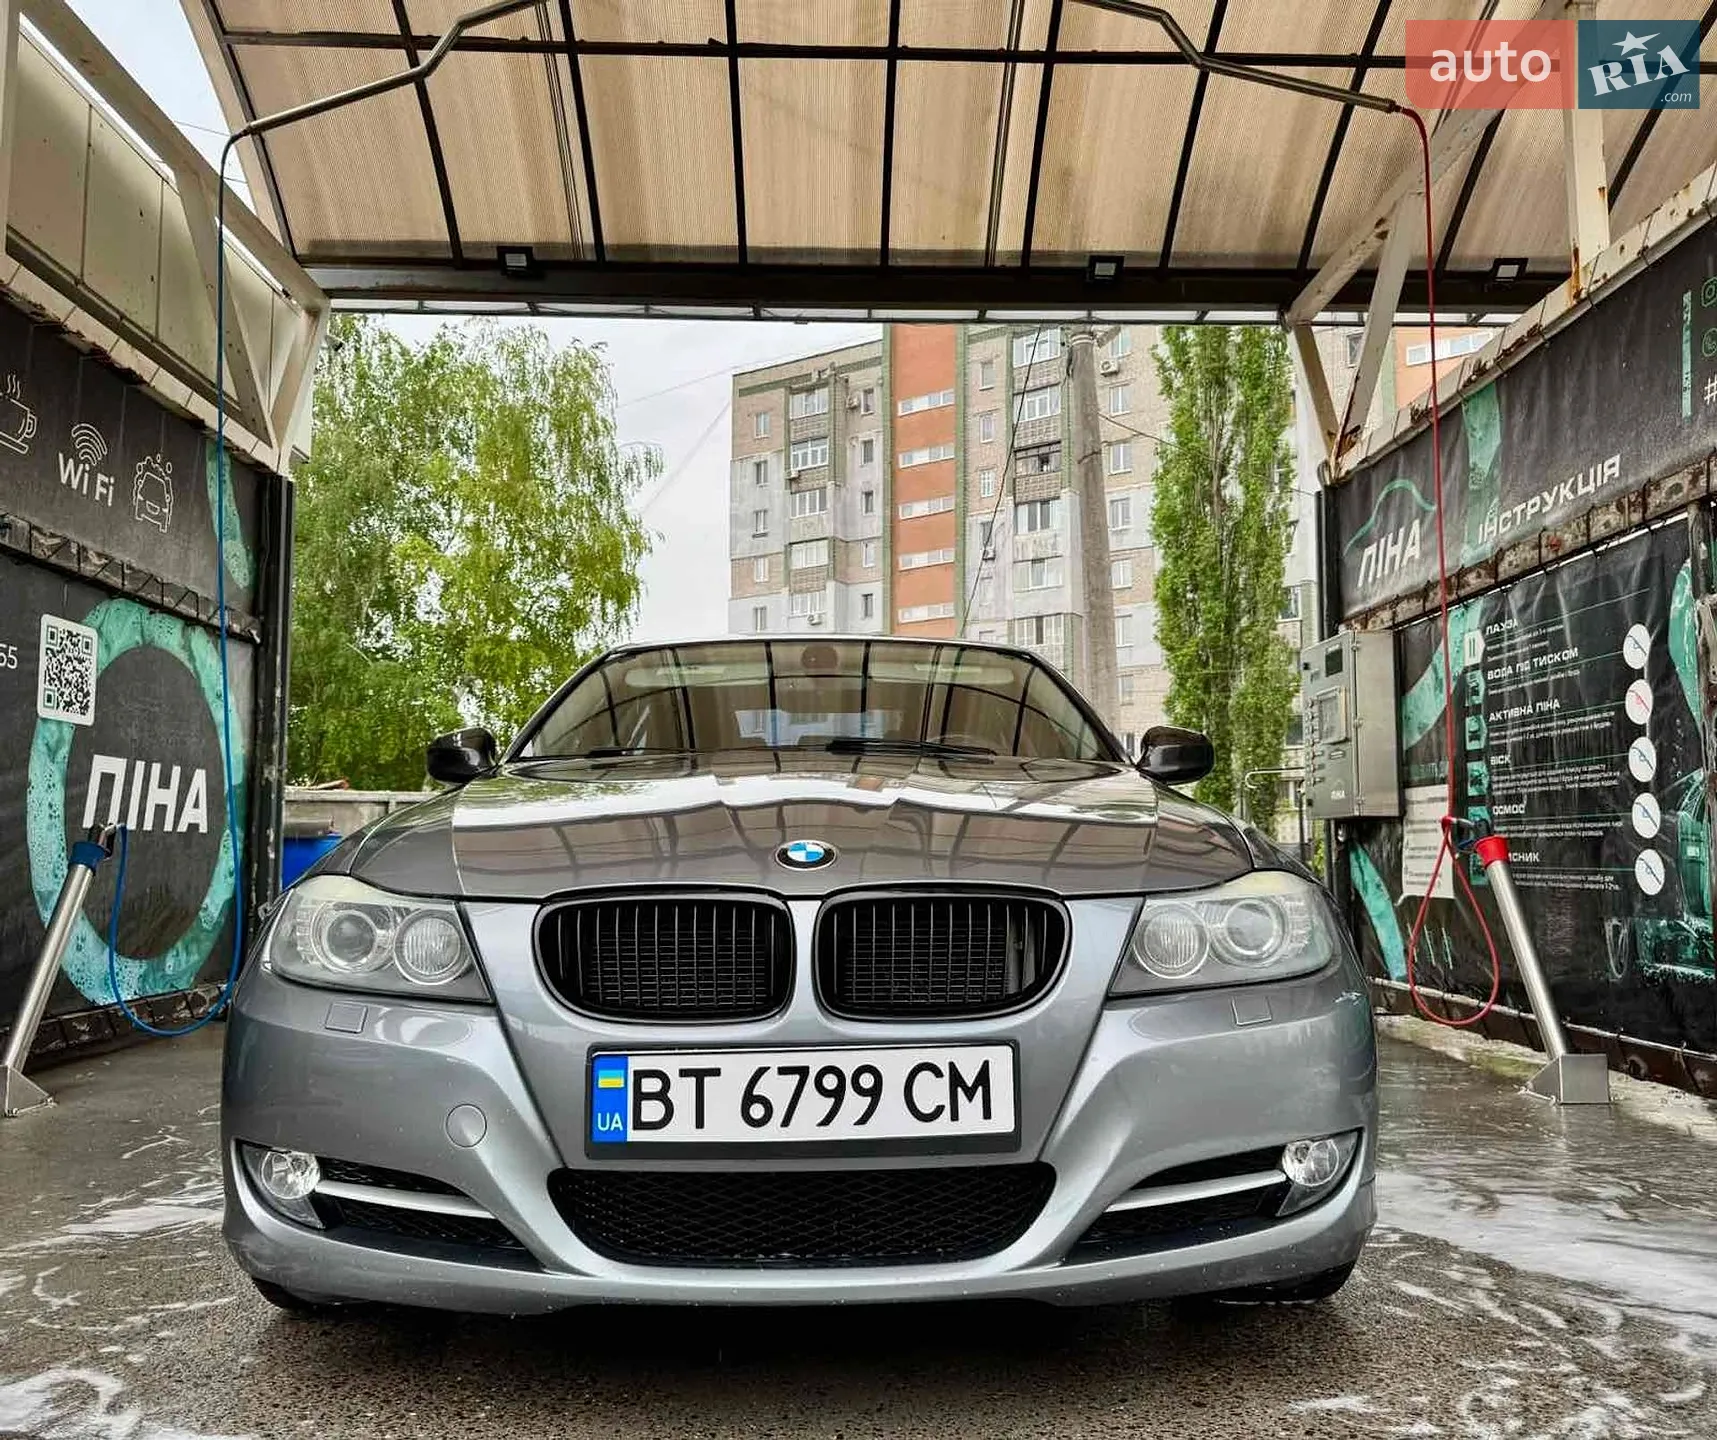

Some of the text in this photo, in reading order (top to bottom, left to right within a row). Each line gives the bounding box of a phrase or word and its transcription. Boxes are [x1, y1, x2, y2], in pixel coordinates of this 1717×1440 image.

[59, 452, 115, 507] Wi Fi
[1478, 453, 1622, 545] ІНСТРУКЦІЯ
[1356, 518, 1421, 588] ПІНА
[1487, 665, 1513, 680] ВОДА
[1532, 647, 1579, 667] ТИСКОМ
[1488, 698, 1561, 722] АКТИВНА ПІНА
[82, 754, 208, 833] ПІНА
[597, 1112, 624, 1132] UA
[631, 1060, 992, 1131] BT 6799 CM
